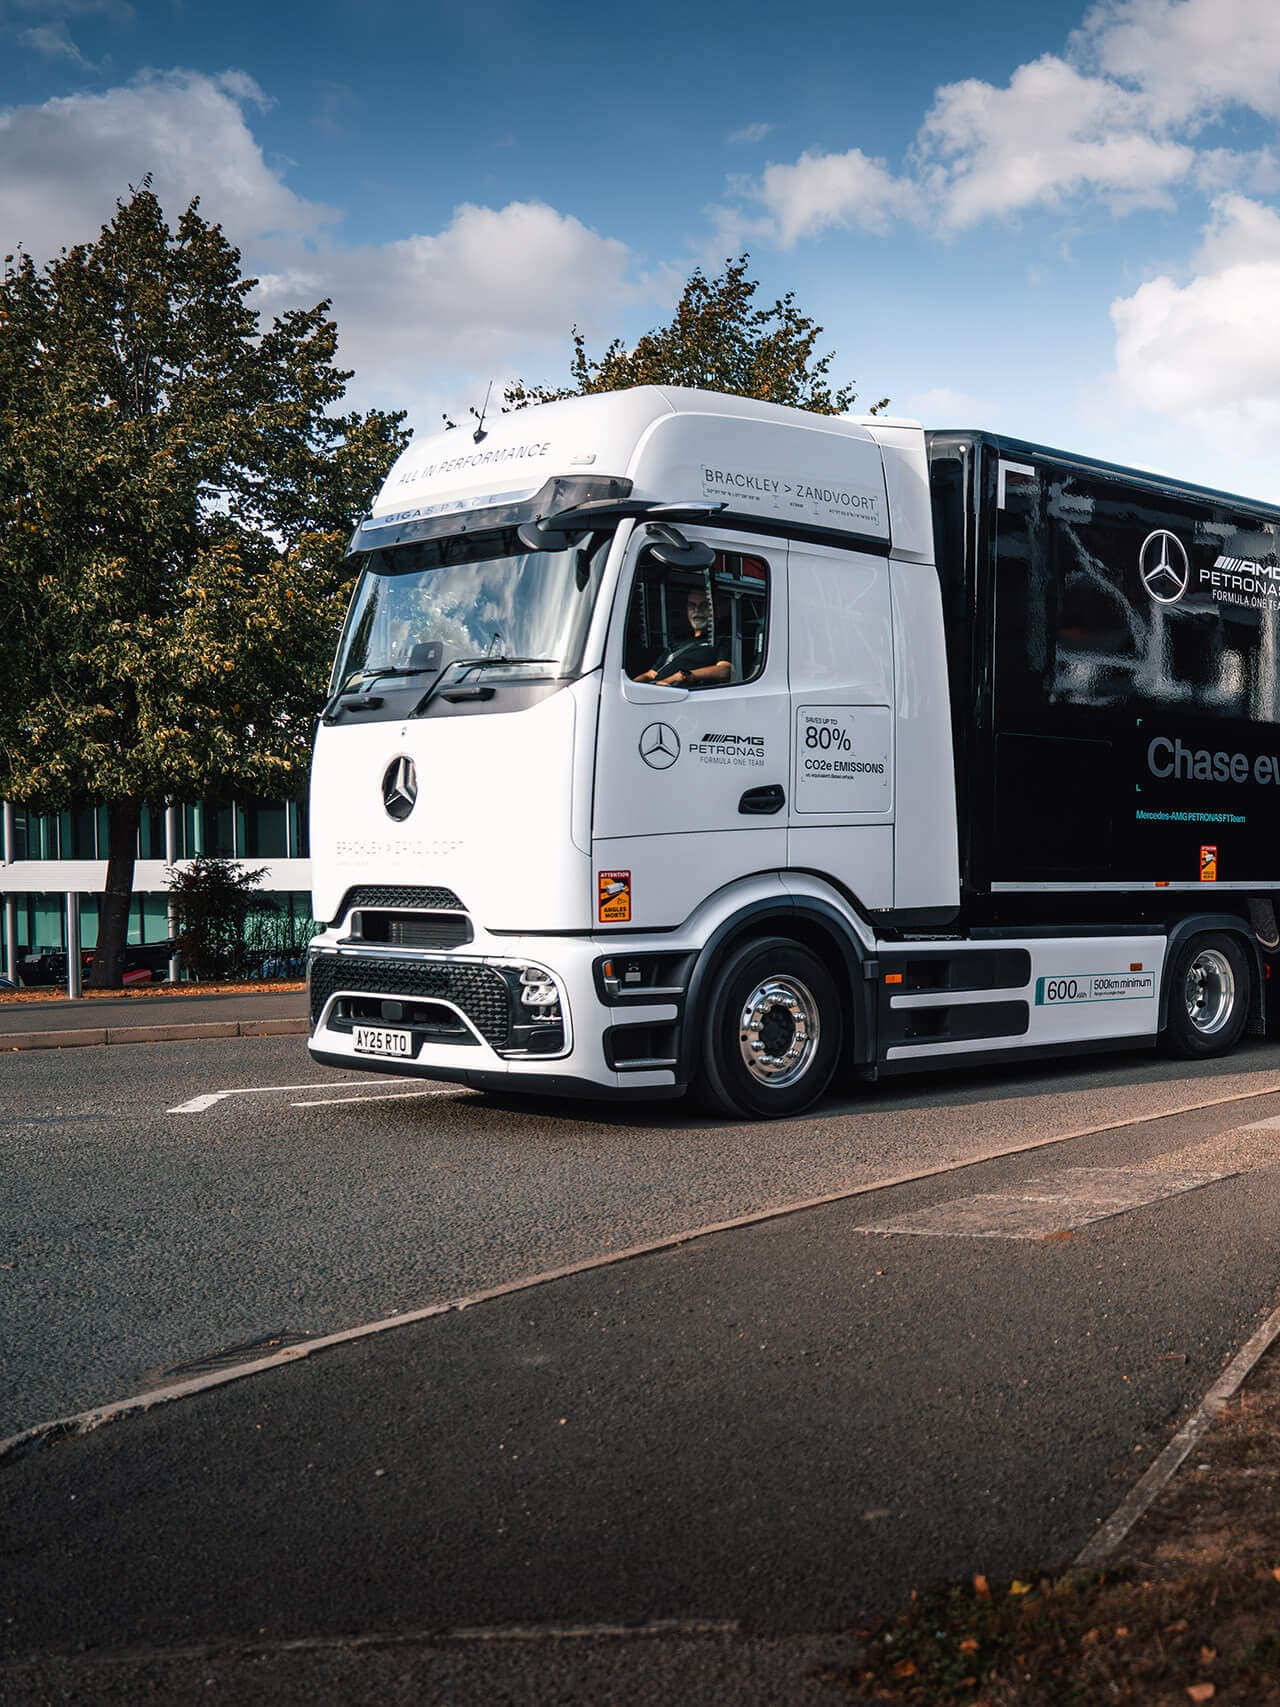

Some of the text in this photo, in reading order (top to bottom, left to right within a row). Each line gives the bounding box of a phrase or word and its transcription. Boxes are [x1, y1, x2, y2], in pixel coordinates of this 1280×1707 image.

[400, 442, 551, 484] ALL IN PERFORMANCE
[705, 469, 876, 510] BRACKLEY ZANDVOORT
[1212, 589, 1249, 606] FORMULA
[1251, 596, 1267, 609] ONE
[722, 734, 764, 745] AMG
[805, 726, 851, 751] 80%
[689, 744, 765, 757] PETRONAS
[1147, 736, 1249, 783] Chase
[700, 757, 764, 767] FORMULA ONE TEAM
[805, 759, 884, 774] CO2e EMISSIONS
[1136, 810, 1187, 821] Mercedes-AMG
[1188, 812, 1222, 823] PETRONAS
[1047, 980, 1077, 1000] 600
[1094, 978, 1152, 990] 500km minimum
[357, 1030, 406, 1052] AY25 RTO
